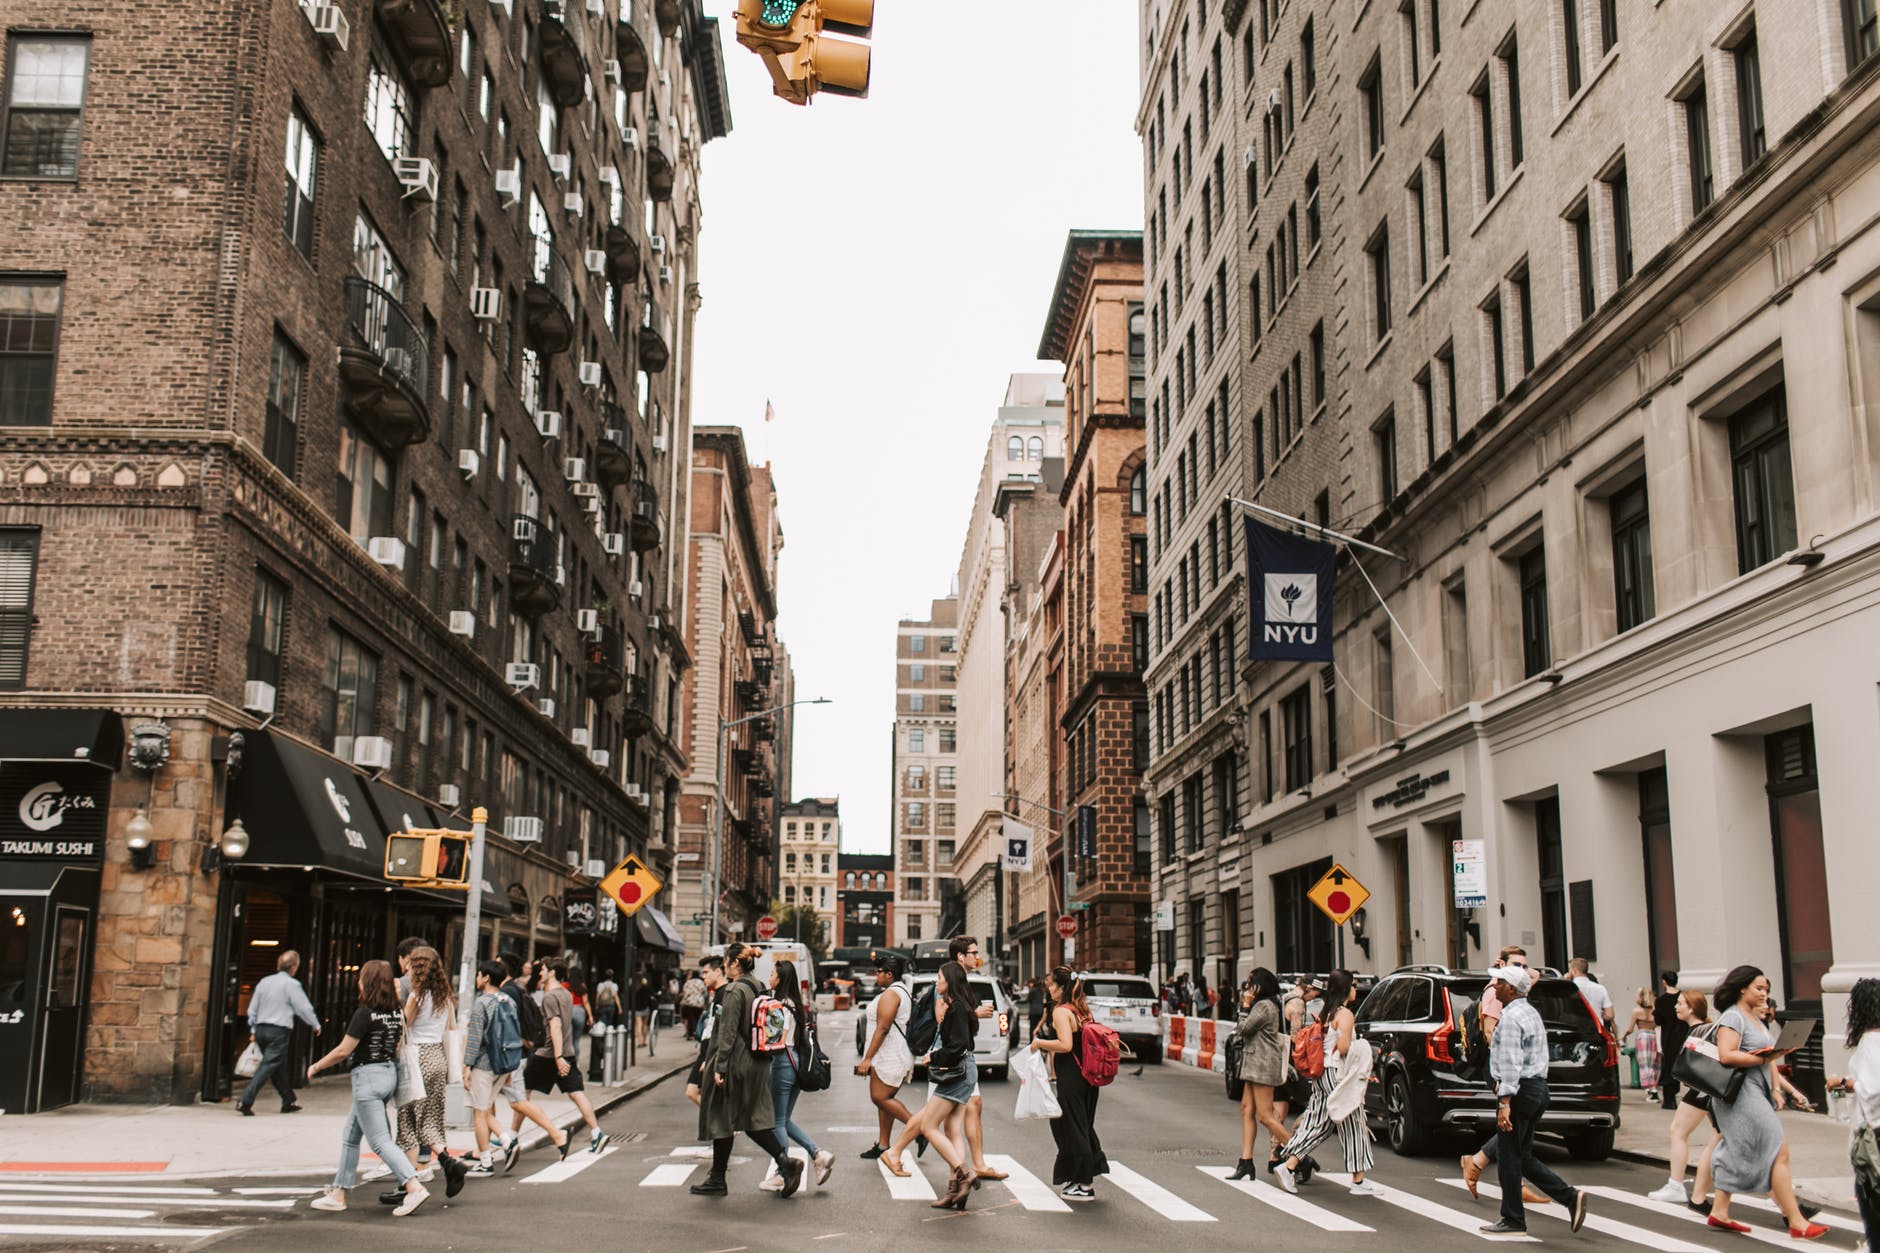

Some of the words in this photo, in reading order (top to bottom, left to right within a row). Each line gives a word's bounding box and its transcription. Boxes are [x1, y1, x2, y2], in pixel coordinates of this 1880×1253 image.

[1263, 624, 1318, 645] NYU
[1, 841, 53, 854] TAKUMI
[55, 842, 94, 856] SUSHI
[1008, 858, 1027, 866] NYU
[758, 922, 777, 932] STOP
[1058, 921, 1076, 931] STOP
